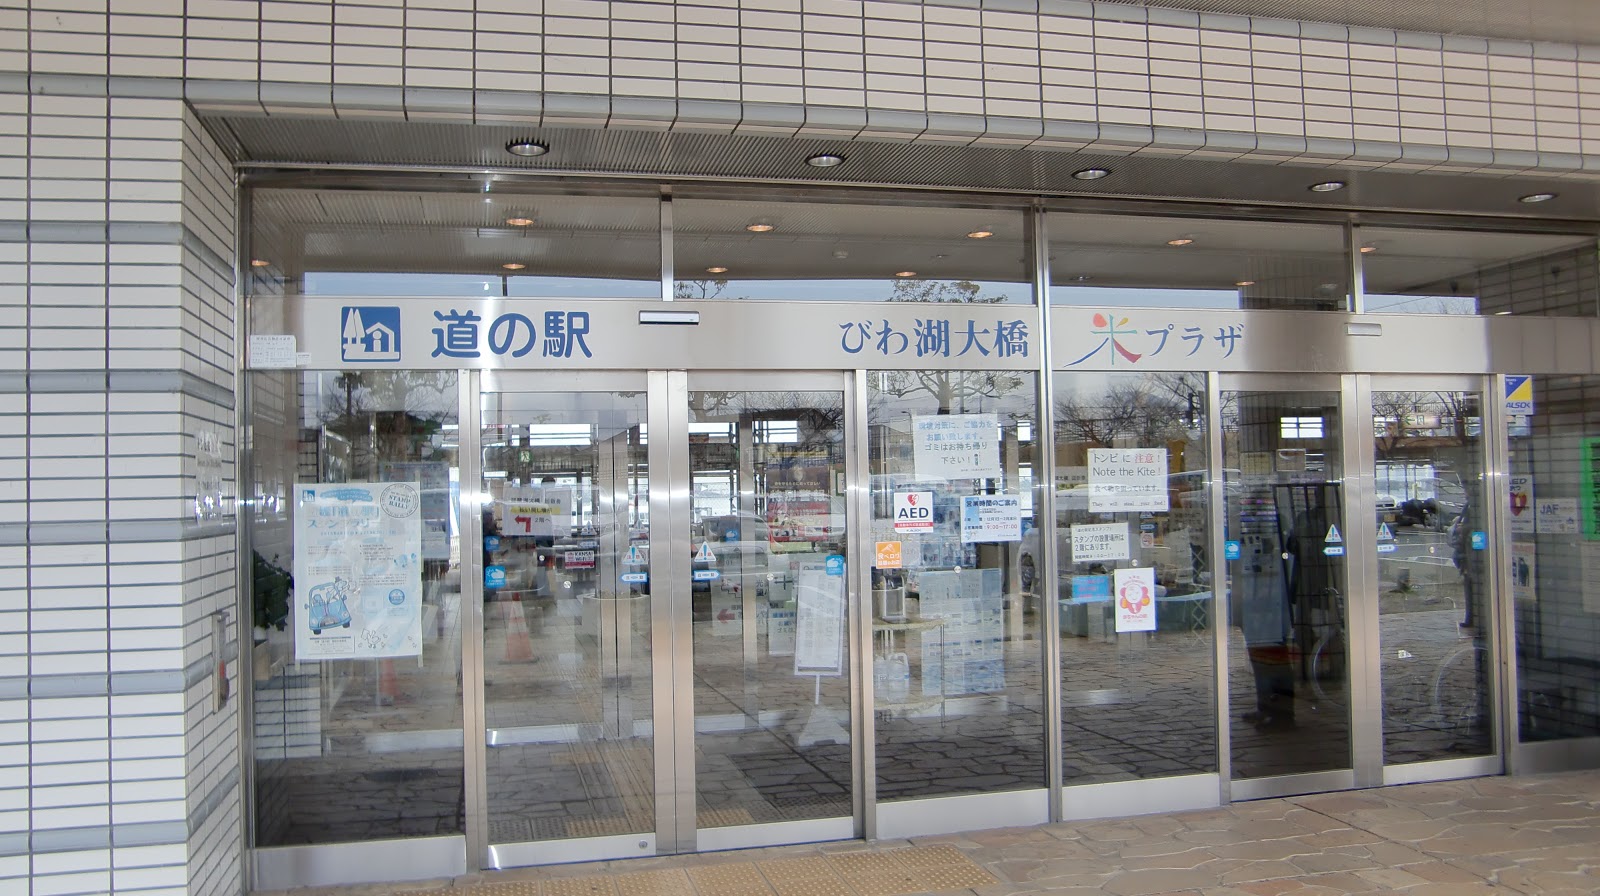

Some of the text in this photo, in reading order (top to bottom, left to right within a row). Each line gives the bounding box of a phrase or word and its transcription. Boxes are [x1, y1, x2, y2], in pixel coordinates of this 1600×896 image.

[431, 309, 1244, 367] 道の駅 びわ湖大橋 米プラザ
[1505, 401, 1531, 409] ALSOK
[924, 441, 988, 451] ゴミはお持ち帰り
[941, 456, 970, 465] 下さい！
[1094, 453, 1118, 463] トンビ
[1122, 454, 1131, 463] に
[1092, 467, 1116, 477] Note
[1118, 467, 1134, 477] the
[388, 494, 411, 503] STAMP
[966, 499, 1018, 507] 営業時間のご案内
[388, 501, 409, 509] RALLY
[1540, 504, 1559, 515] JAF
[898, 507, 929, 519] AED
[1074, 534, 1125, 543] スタンプの設置場所は
